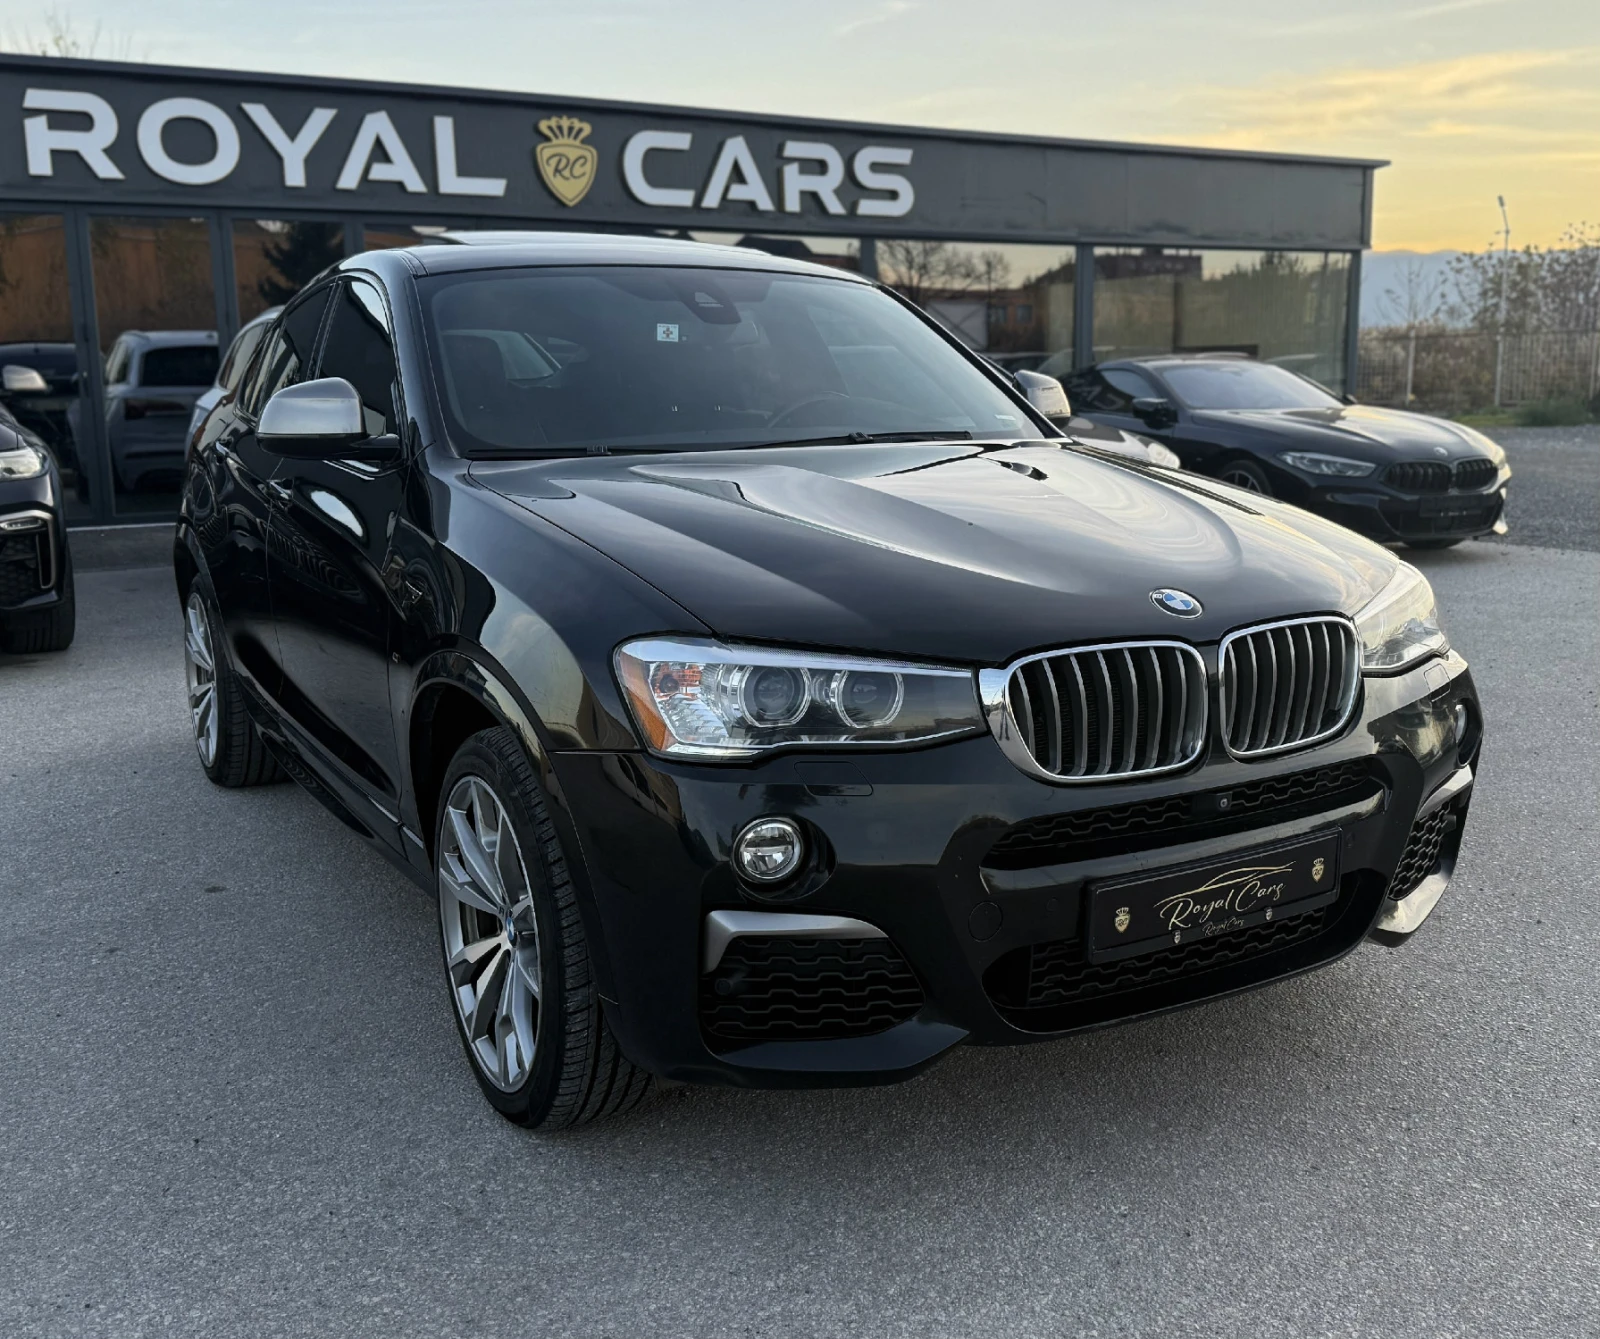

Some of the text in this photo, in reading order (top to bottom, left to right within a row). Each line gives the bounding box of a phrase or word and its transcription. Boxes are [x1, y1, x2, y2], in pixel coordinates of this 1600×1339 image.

[22, 87, 915, 218] ROYAL CARS
[546, 152, 588, 180] RC
[1159, 880, 1286, 931] Royal Cars
